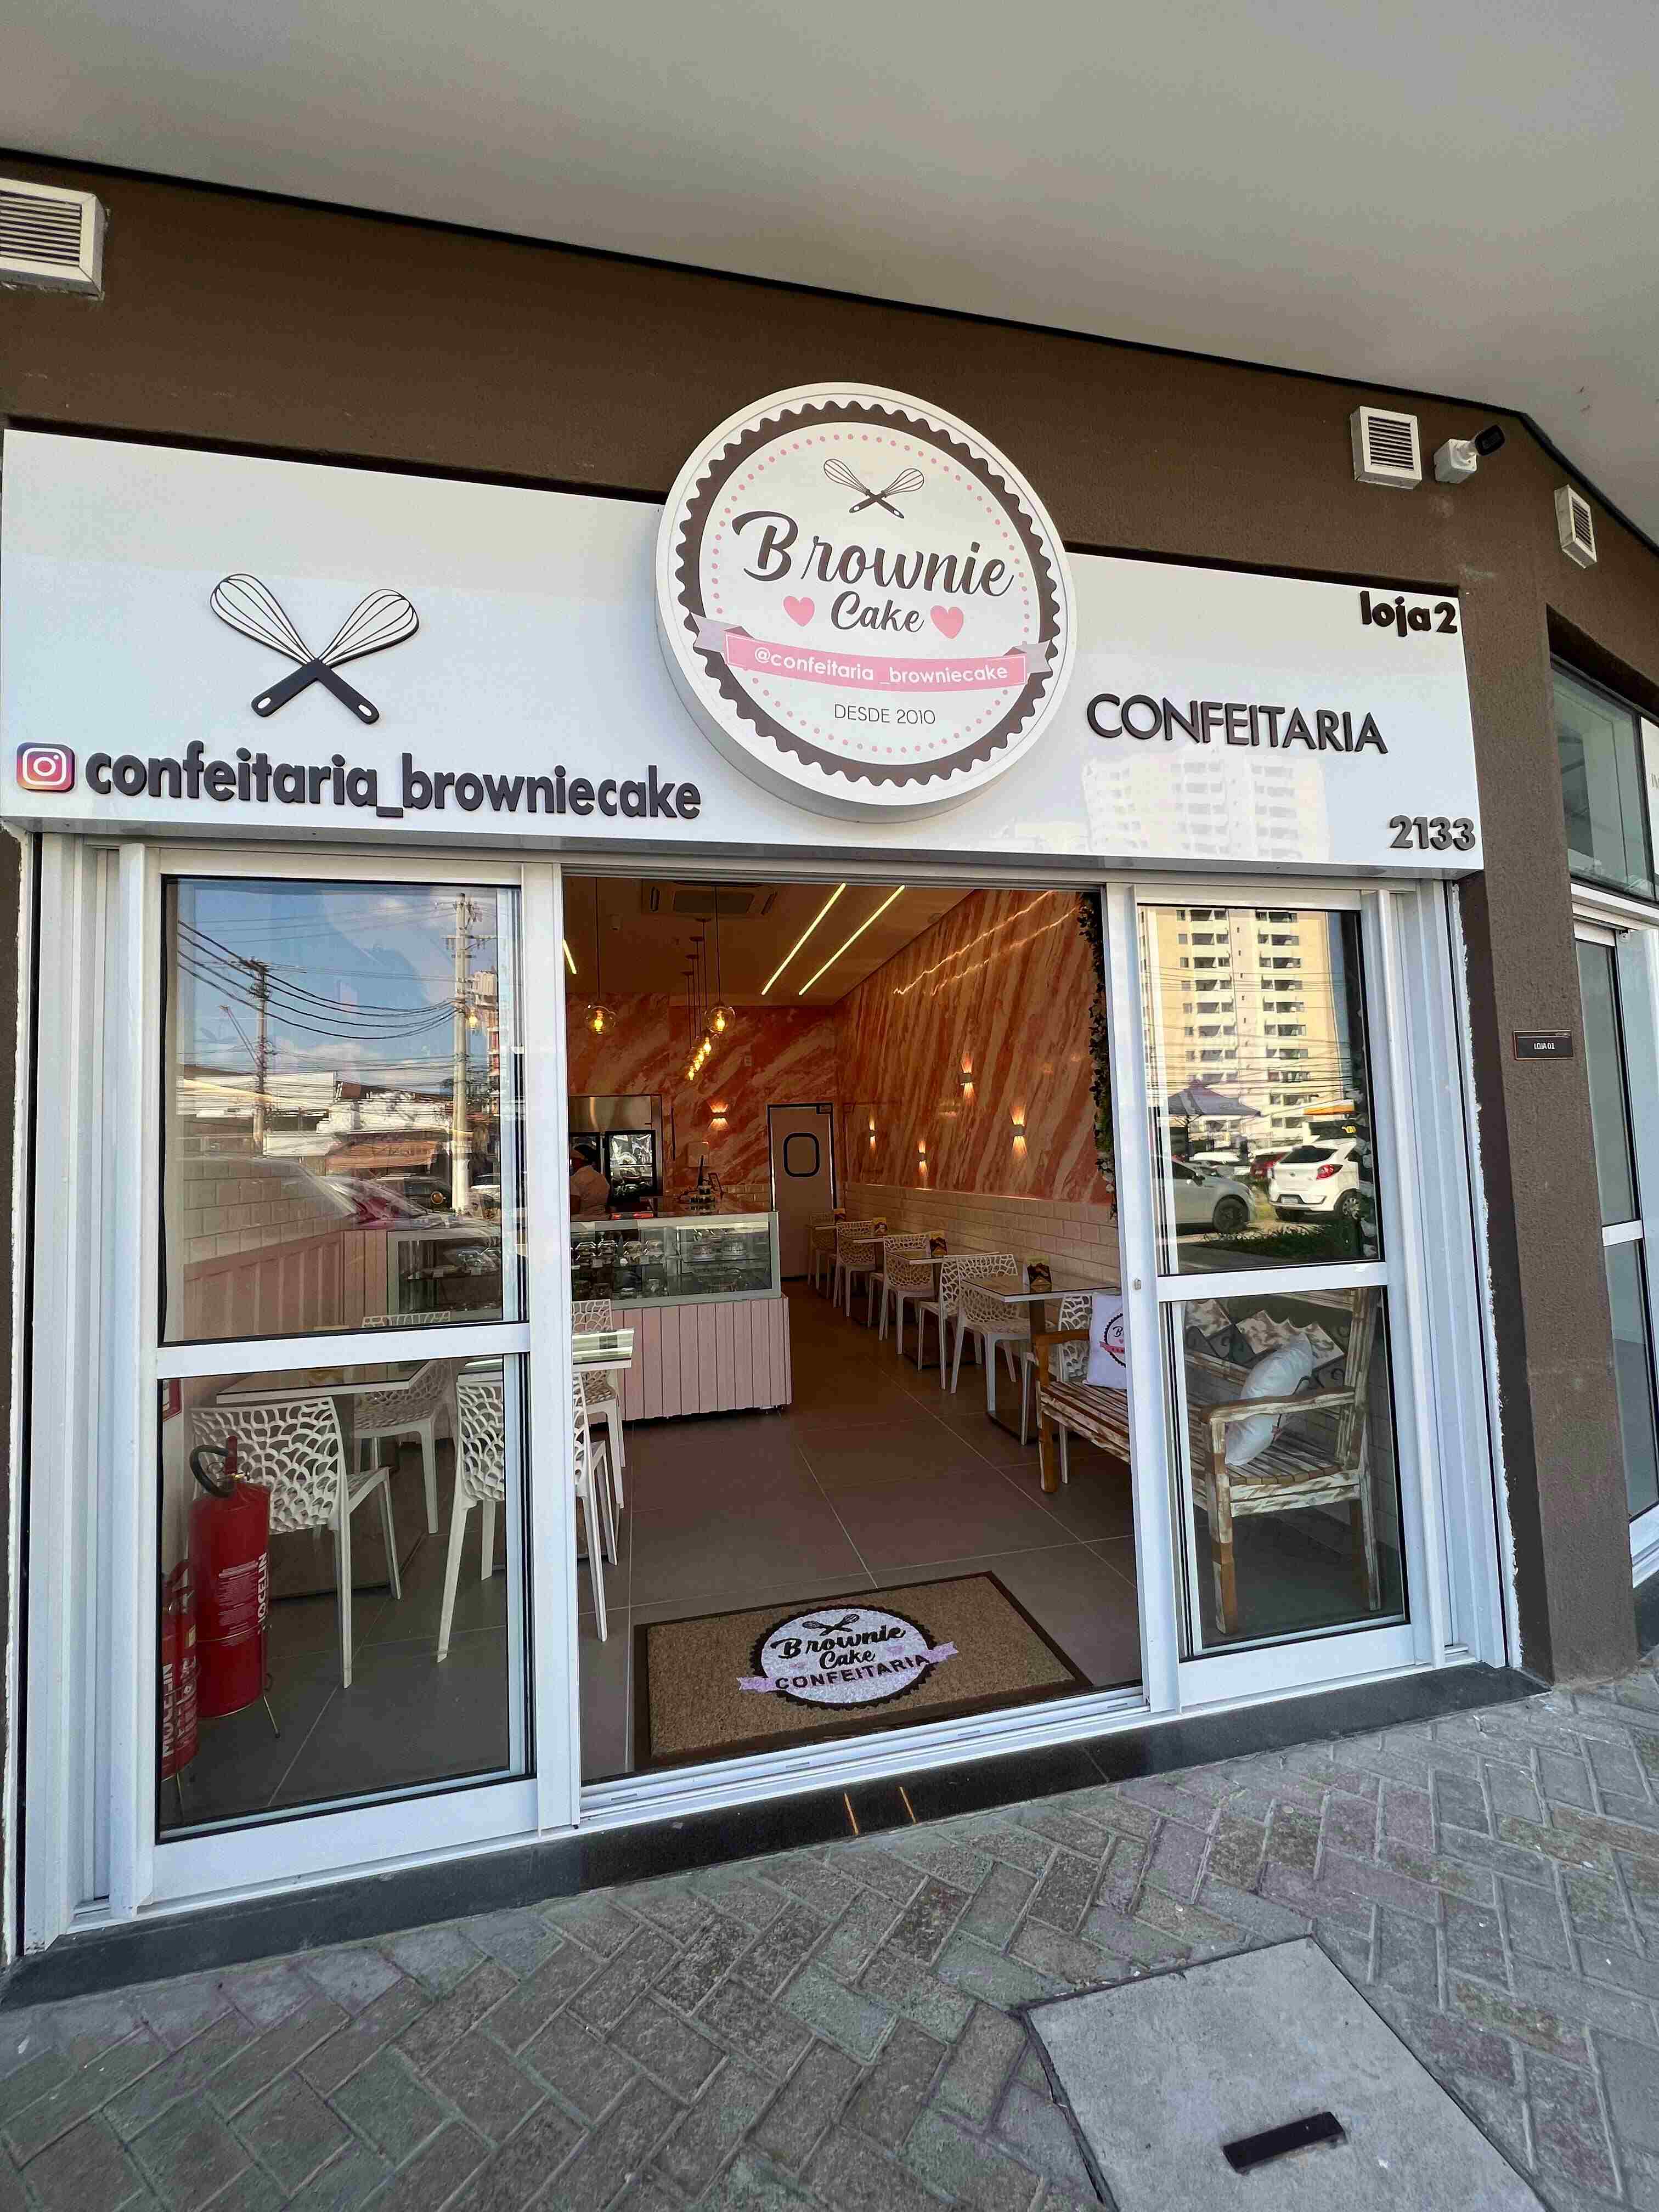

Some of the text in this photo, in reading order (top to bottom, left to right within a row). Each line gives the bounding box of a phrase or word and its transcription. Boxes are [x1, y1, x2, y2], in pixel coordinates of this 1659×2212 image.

[731, 510, 1014, 597] Brownie
[831, 590, 924, 633] Cake
[834, 704, 936, 725] DESDE 2010
[1086, 693, 1389, 754] CONFEITARIA
[85, 740, 701, 819] confeitaria_browniecake
[1389, 815, 1476, 851] 2133
[770, 1623, 906, 1659] Brownie
[774, 1654, 930, 1689] CONFEITARIA
[819, 1650, 876, 1669] Cake
